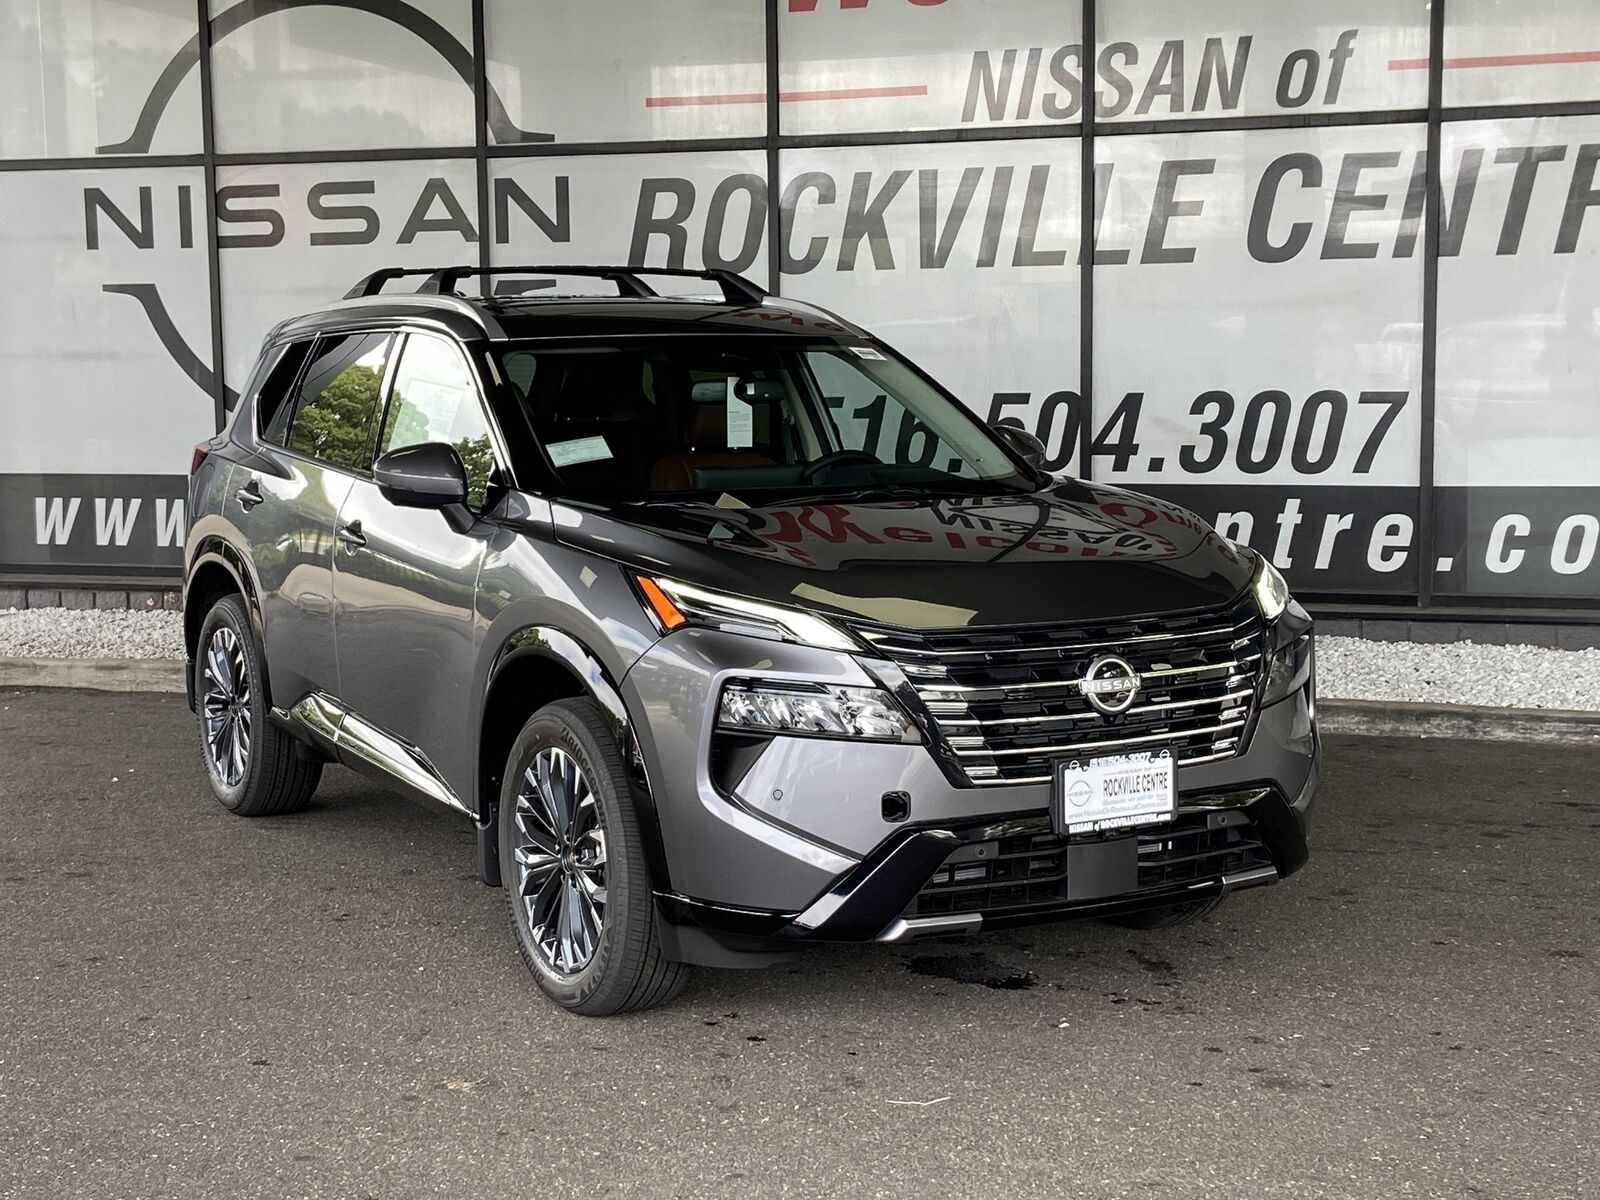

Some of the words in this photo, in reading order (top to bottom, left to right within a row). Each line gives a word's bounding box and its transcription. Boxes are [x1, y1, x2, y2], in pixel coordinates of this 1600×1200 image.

[960, 35, 1254, 122] NISSAN
[1275, 29, 1359, 109] of
[83, 175, 571, 251] NISSAN
[626, 158, 1217, 275] ROCKVILLE
[823, 389, 1410, 475] 16.504.3007
[1081, 677, 1141, 693] NISSAN
[1103, 775, 1140, 797] ROCKVILLE
[1141, 772, 1168, 792] CENTRE
